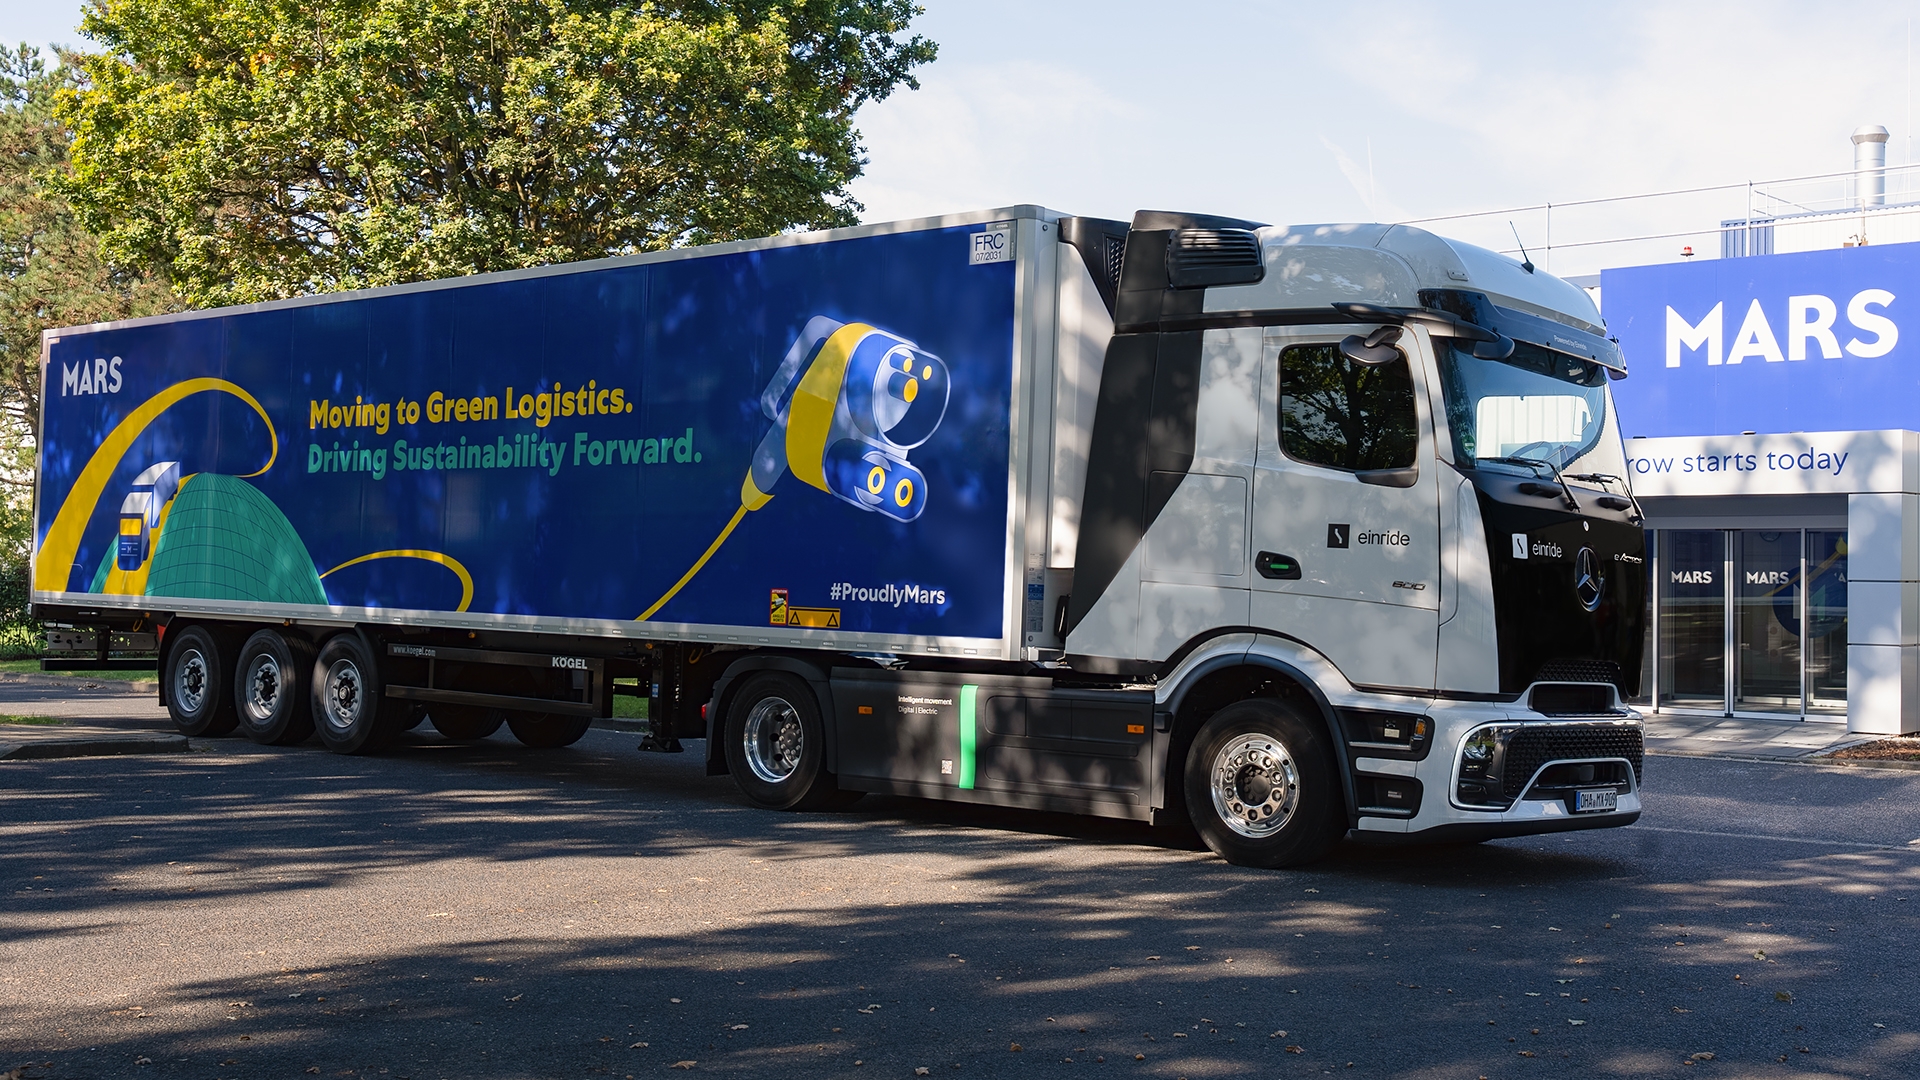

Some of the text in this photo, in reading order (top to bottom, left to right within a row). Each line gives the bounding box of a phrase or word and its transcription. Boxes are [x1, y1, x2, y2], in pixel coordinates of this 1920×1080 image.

[975, 232, 1004, 251] FRC
[975, 250, 1002, 262] 07/2031
[1666, 288, 1899, 369] MARS
[62, 356, 123, 397] MARS
[309, 379, 633, 435] Moving to Green Logistics.
[307, 427, 702, 481] Driving Sustainability Forward.
[1683, 451, 1757, 473] starts
[1766, 446, 1849, 476] today
[1357, 529, 1411, 546] einride
[1532, 540, 1563, 558] einride
[1671, 570, 1713, 584] MARS
[1746, 571, 1790, 585] MARS
[830, 582, 946, 608] #ProudlyMars
[552, 656, 588, 670] KÖGEL
[898, 695, 924, 704] Intelligent
[898, 706, 914, 714] Digital
